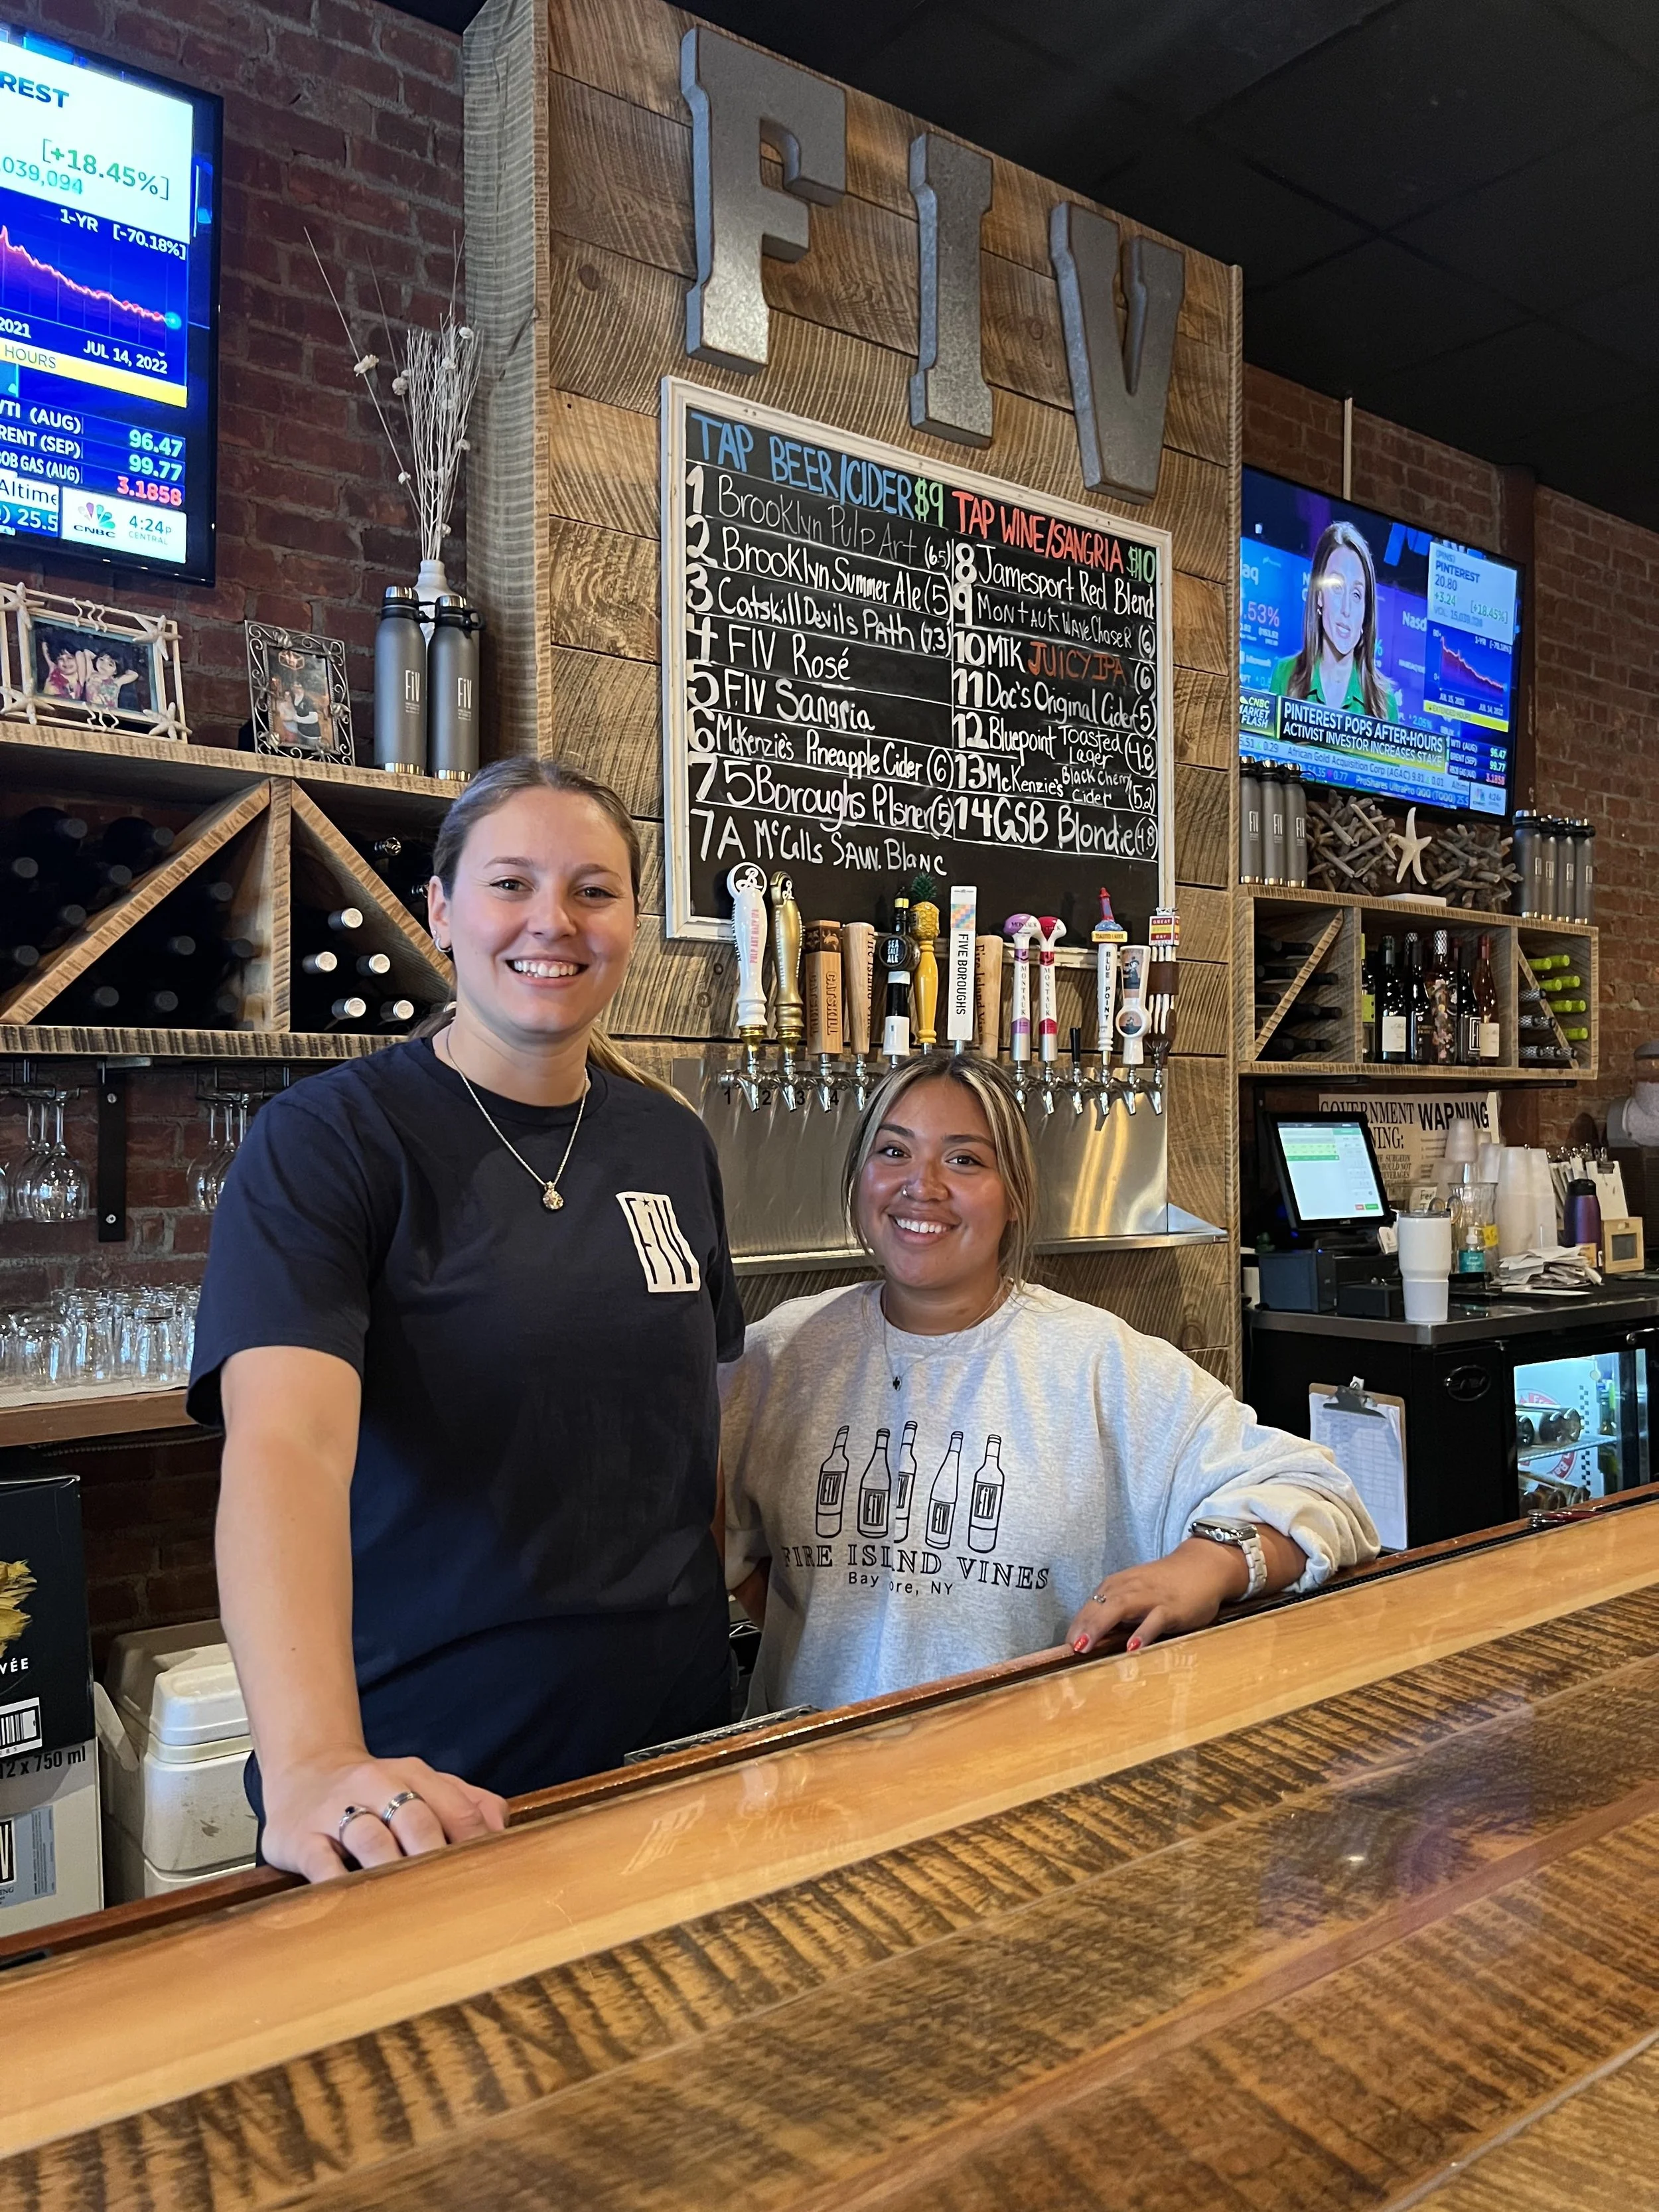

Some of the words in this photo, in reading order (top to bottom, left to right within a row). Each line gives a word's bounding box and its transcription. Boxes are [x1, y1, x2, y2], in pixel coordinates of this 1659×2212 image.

[42, 138, 169, 201] [+18.45%]
[60, 208, 98, 233] 1-YR
[113, 223, 186, 260] [-70.18%]
[0, 318, 31, 338] 2021
[5, 344, 57, 369] HOURS
[84, 340, 109, 358] JUL
[112, 347, 133, 366] 14,
[136, 354, 168, 374] 2022
[30, 406, 82, 434] (AUG)
[129, 429, 183, 458] 96.47
[20, 455, 44, 475] GAS
[46, 461, 80, 484] (AUG)
[116, 475, 182, 506] 3.1858
[40, 435, 81, 459] (SEP)
[129, 454, 182, 482] 99.77
[691, 412, 753, 472] TAP
[914, 477, 943, 527] $9
[74, 525, 116, 538] CNBC
[686, 465, 704, 514] 1
[828, 504, 875, 552] Pulp
[879, 522, 916, 564] Art
[952, 491, 995, 540] TAP
[1000, 506, 1124, 574] WINE/SANGRIA
[1127, 546, 1155, 583] $10
[129, 530, 169, 546] CENTRAL
[686, 515, 717, 569] 2
[832, 557, 890, 603] Summer
[893, 571, 921, 611] Ale
[924, 574, 954, 625] (5)
[955, 543, 977, 585] 8
[976, 544, 1074, 601] Jamesport
[1080, 570, 1107, 611] Red
[1114, 578, 1154, 619] Blend
[1435, 574, 1457, 591] 20.80
[1436, 561, 1480, 583] PINTEREST
[686, 563, 713, 611] 3
[718, 577, 801, 626] Catskill
[804, 597, 858, 635] Devils
[953, 584, 973, 626] 9
[1138, 625, 1155, 659] (6)
[1435, 591, 1456, 607] +3.24
[1471, 600, 1508, 624] [+18.45%]
[686, 612, 718, 662] 4
[729, 625, 775, 670] FIV
[793, 632, 851, 681] Rosé
[954, 631, 985, 666] 10
[1028, 641, 1092, 679] JUICY
[1093, 654, 1127, 686] IPA
[1134, 662, 1156, 697] (6)
[687, 664, 719, 707] 5
[724, 668, 766, 715] FIV
[776, 678, 875, 731] Sangria
[953, 668, 983, 708] 11
[987, 672, 1031, 709] Doc's
[1034, 681, 1098, 725] Original
[1101, 692, 1135, 729] Cider
[1133, 696, 1157, 738] (5)
[1248, 697, 1269, 709] CNBC
[954, 711, 989, 749] 12
[989, 717, 1057, 767] Bluepoint
[1058, 725, 1123, 755] Toasted
[1242, 715, 1269, 728] FLASH
[1285, 701, 1342, 730] PINTEREST
[1345, 716, 1372, 737] POPS
[1374, 722, 1443, 753] AFTER-HOURS
[687, 705, 715, 753] 6
[806, 729, 880, 779] Pineapple
[883, 742, 923, 781] Cider
[926, 747, 954, 790] (6)
[1069, 747, 1114, 770] Lager
[1283, 722, 1324, 742] ACTIVIST
[1326, 731, 1369, 751] INVESTOR
[1370, 741, 1415, 761] INCREASES
[1417, 751, 1442, 767] STAKE
[1287, 747, 1313, 760] African
[1314, 752, 1330, 763] Gold
[1333, 756, 1368, 771] Acquisition
[1370, 765, 1385, 776] Corp
[1387, 767, 1411, 780] (AGAC)
[1489, 761, 1506, 772] 99.77
[1490, 747, 1507, 759] 96.47
[688, 751, 717, 801] 7
[873, 783, 930, 830] Pilsner
[930, 794, 954, 836] (5)
[954, 754, 987, 790] 13
[1061, 766, 1095, 786] Black
[1098, 771, 1131, 793] Cherry
[1355, 776, 1388, 789] ProShares
[1390, 782, 1415, 794] UltraPro
[1072, 788, 1112, 807] Cider
[1129, 783, 1155, 814] (5.2)
[954, 796, 993, 837] 14
[993, 797, 1049, 844] GSB
[1058, 804, 1135, 856] Blondie
[887, 954, 899, 964] ALE
[958, 934, 968, 956] FIVE
[826, 971, 839, 1035] CATSKILL
[956, 960, 968, 1015] BOROUGHS
[781, 1545, 832, 1567] FIRE
[847, 1544, 941, 1574] ISLND
[957, 1556, 1050, 1589] VINES
[849, 1572, 879, 1587] Bay
[931, 1581, 953, 1595] NY
[0, 1658, 29, 1674] VÉE
[21, 1761, 30, 1775] x
[35, 1751, 62, 1772] 750
[68, 1745, 86, 1765] ml
